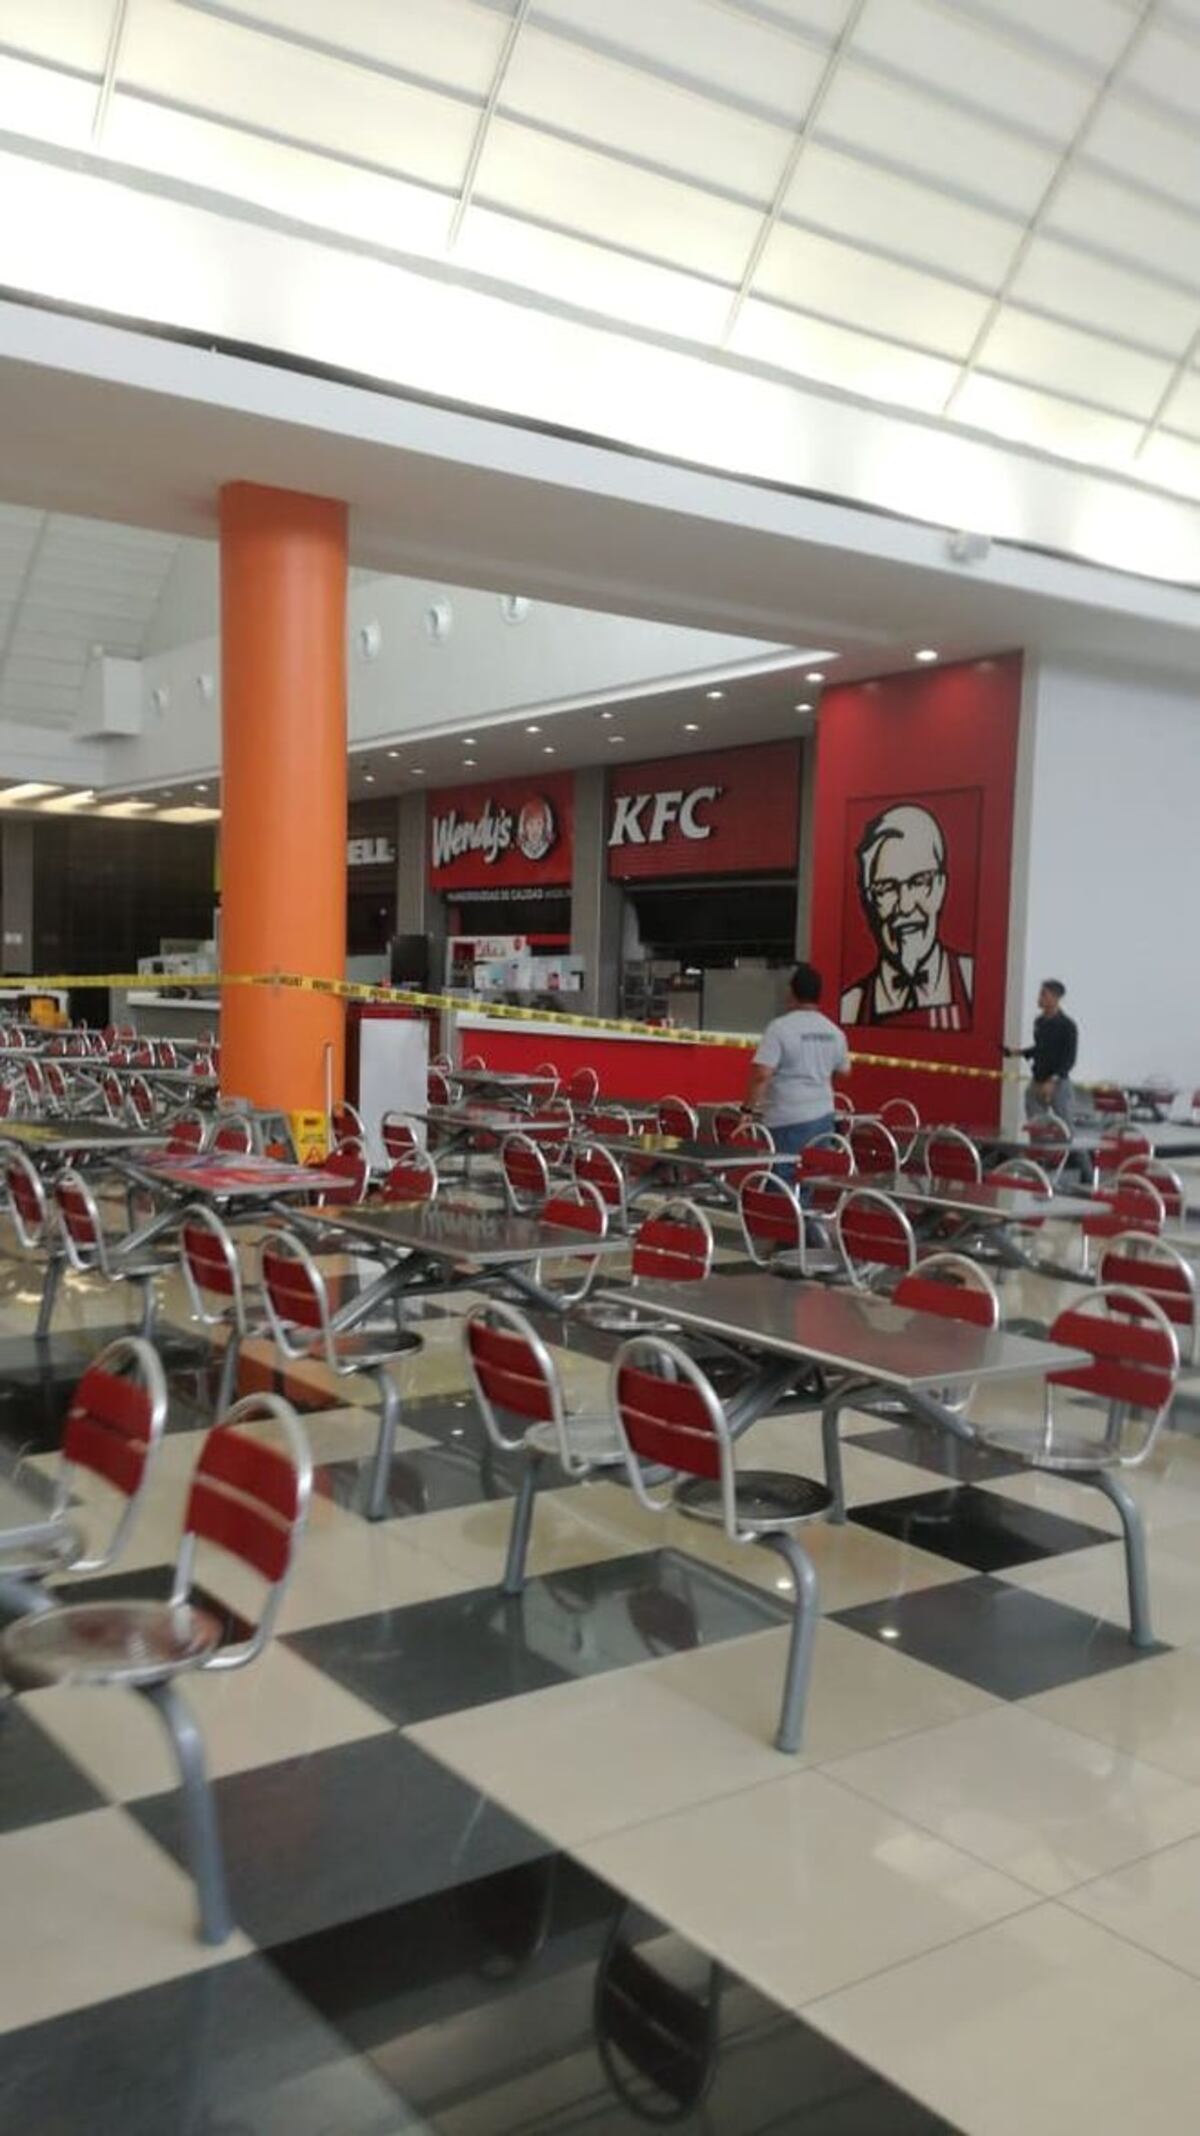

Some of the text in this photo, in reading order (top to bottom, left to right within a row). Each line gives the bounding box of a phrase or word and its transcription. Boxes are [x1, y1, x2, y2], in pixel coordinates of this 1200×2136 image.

[432, 799, 512, 868] Wendy's
[608, 786, 717, 846] KFC
[347, 838, 395, 865] ELL
